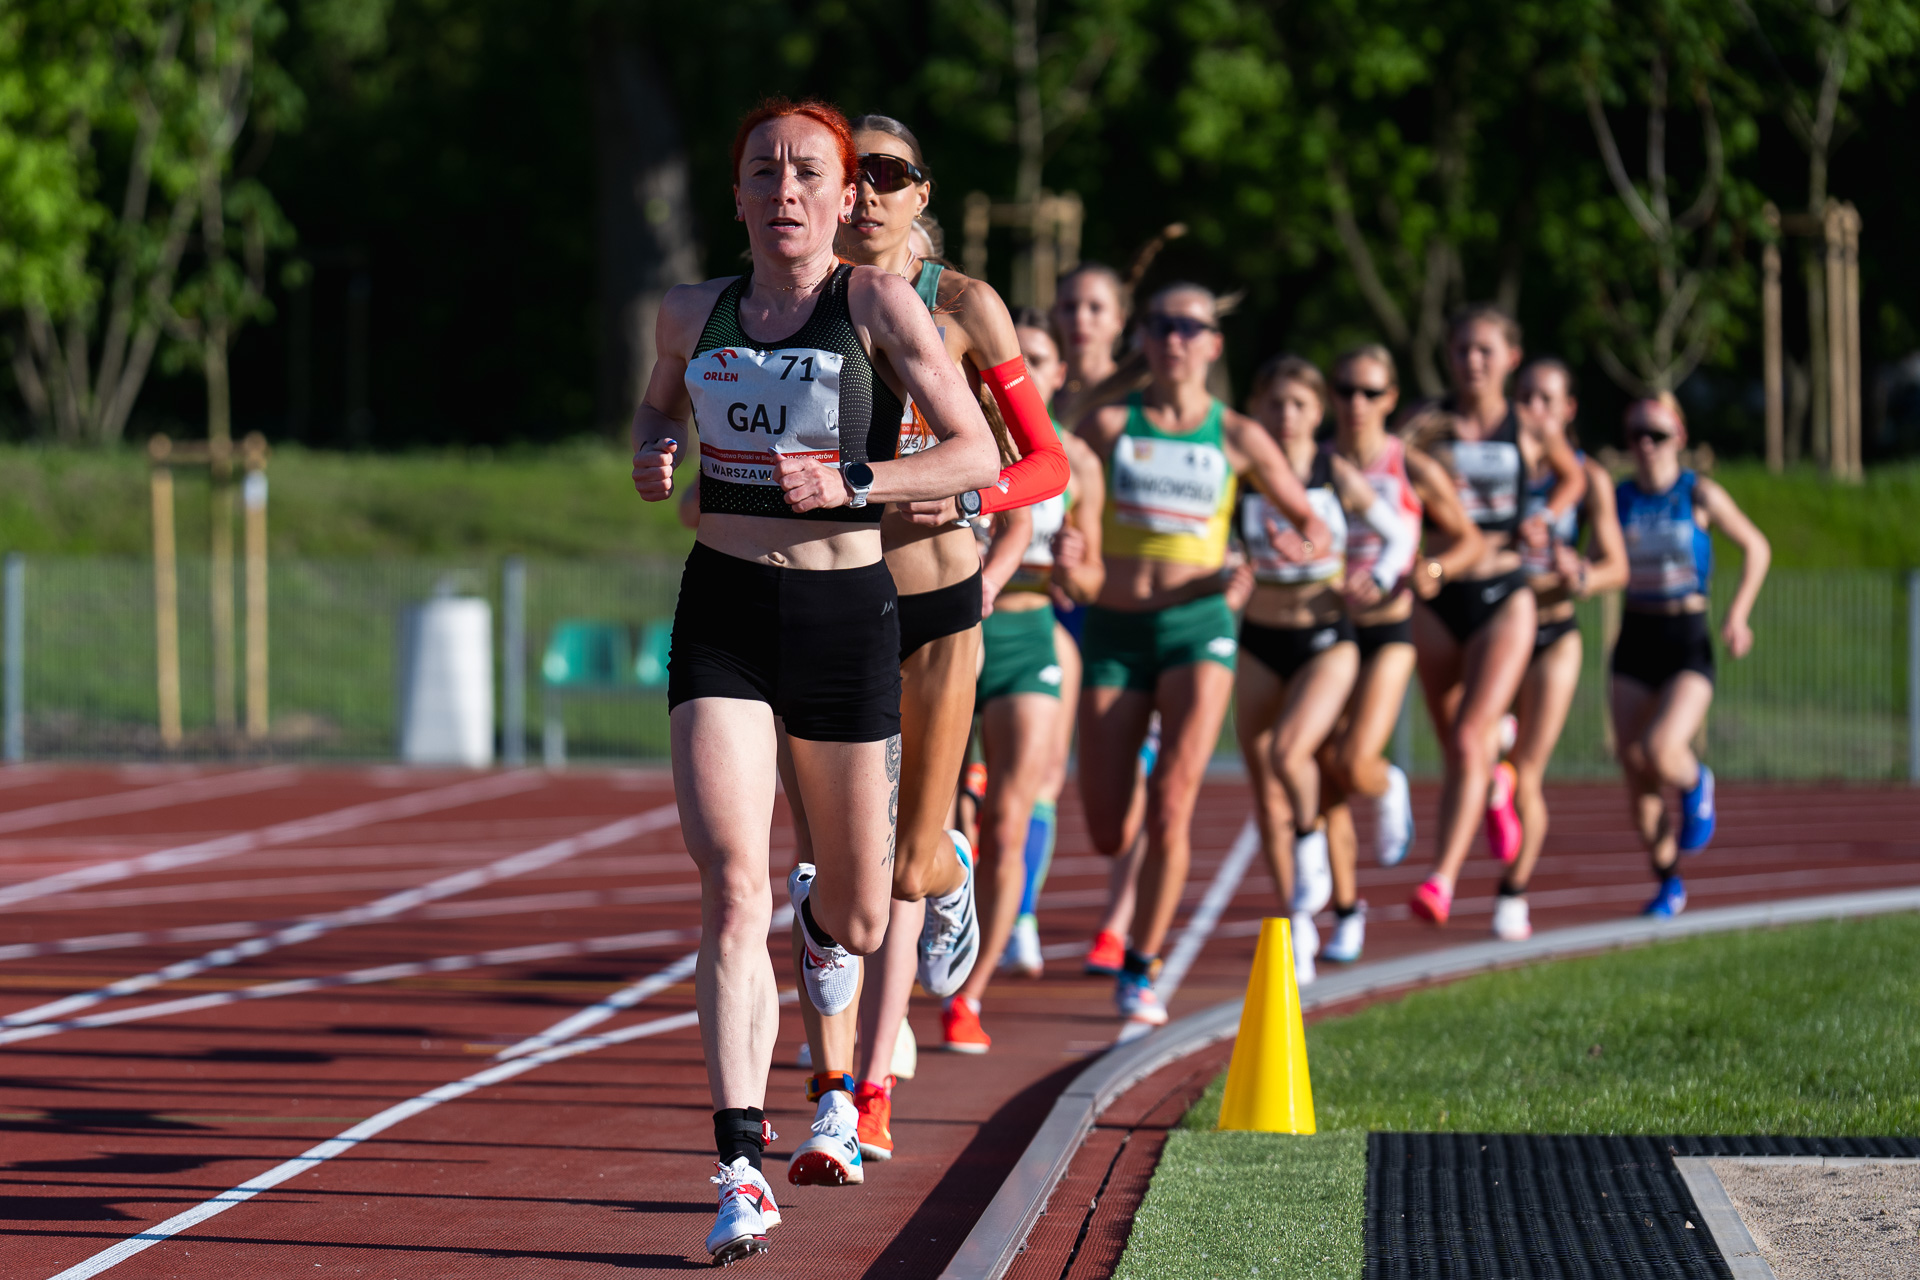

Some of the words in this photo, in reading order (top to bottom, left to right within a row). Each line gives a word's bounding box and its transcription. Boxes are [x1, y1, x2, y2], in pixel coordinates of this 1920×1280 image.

[703, 371, 739, 382] ORLEN
[780, 355, 814, 382] 71
[727, 402, 787, 435] GAJ
[712, 463, 772, 480] WARSZAW
